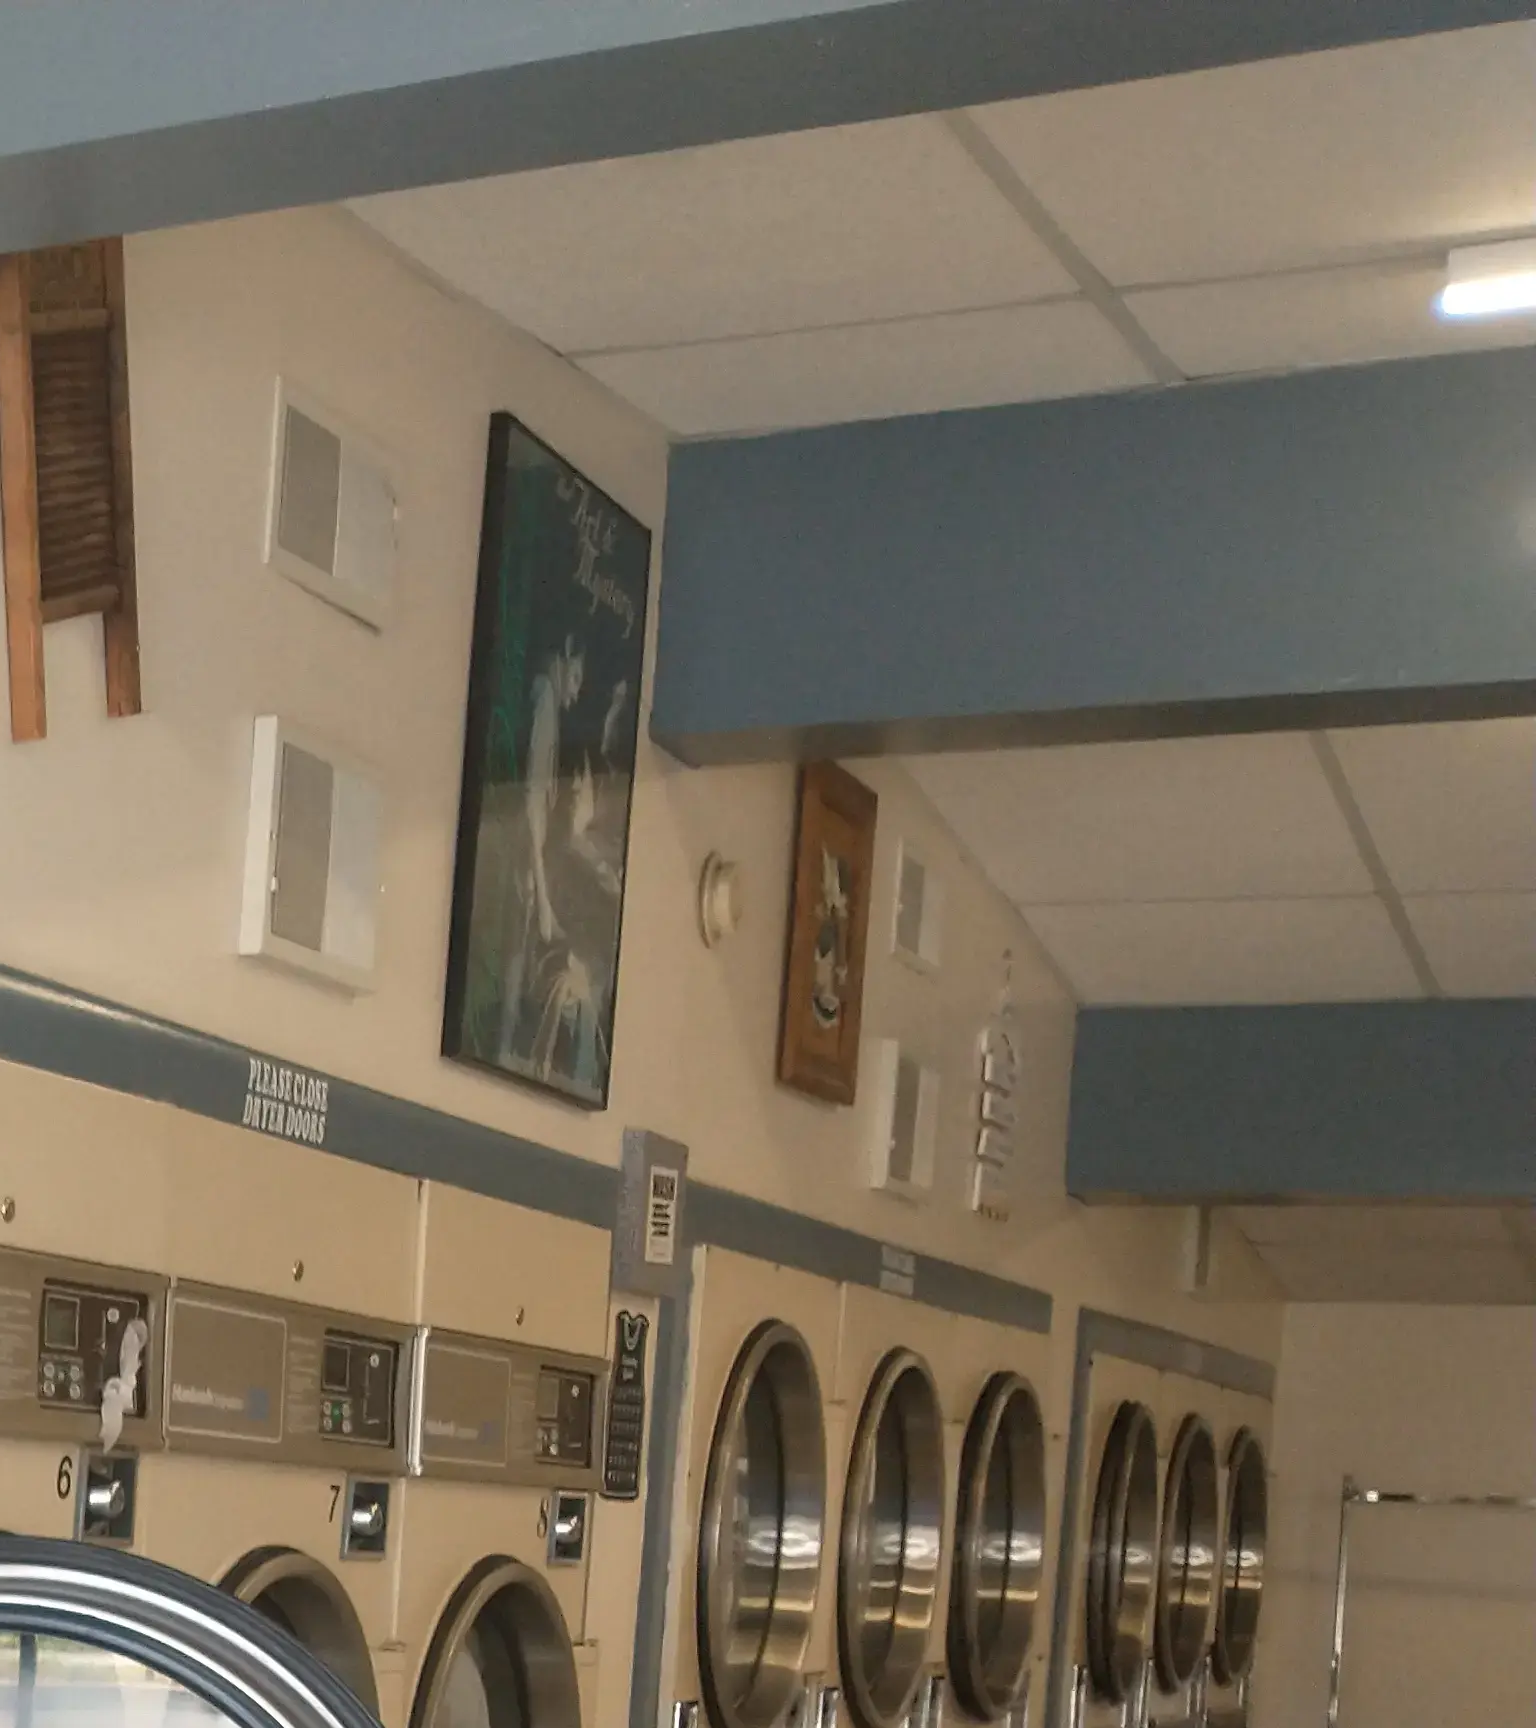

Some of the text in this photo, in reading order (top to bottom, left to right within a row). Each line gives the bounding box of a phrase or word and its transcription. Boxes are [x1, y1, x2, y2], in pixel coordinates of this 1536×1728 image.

[247, 1057, 328, 1113] PLEASE CLOSE
[243, 1093, 326, 1145] DRYER DOORS
[56, 1455, 73, 1500] 6
[328, 1484, 340, 1523] 7
[536, 1497, 550, 1539] 8
